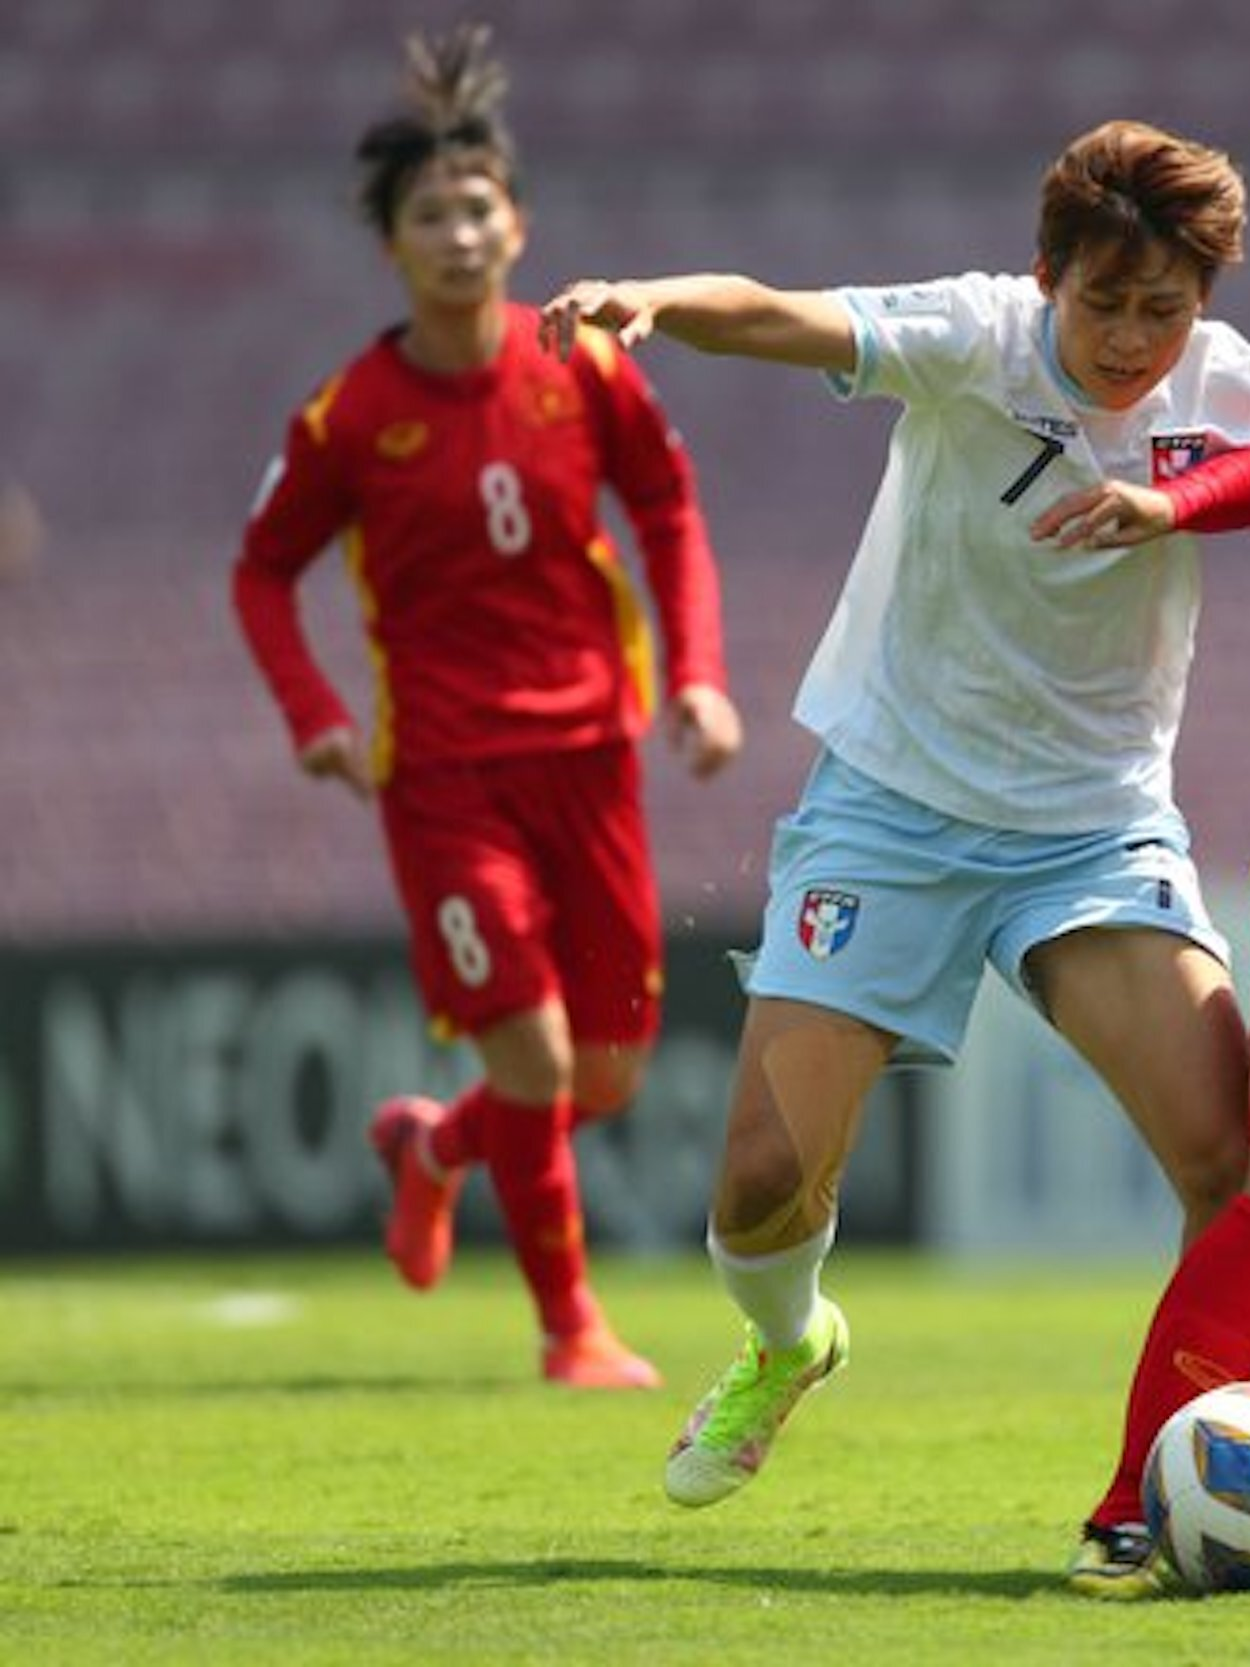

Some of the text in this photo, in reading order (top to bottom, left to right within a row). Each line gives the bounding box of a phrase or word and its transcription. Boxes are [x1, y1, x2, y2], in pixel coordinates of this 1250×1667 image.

[480, 461, 531, 554] 8
[999, 428, 1064, 506] 7
[438, 896, 490, 986] 8
